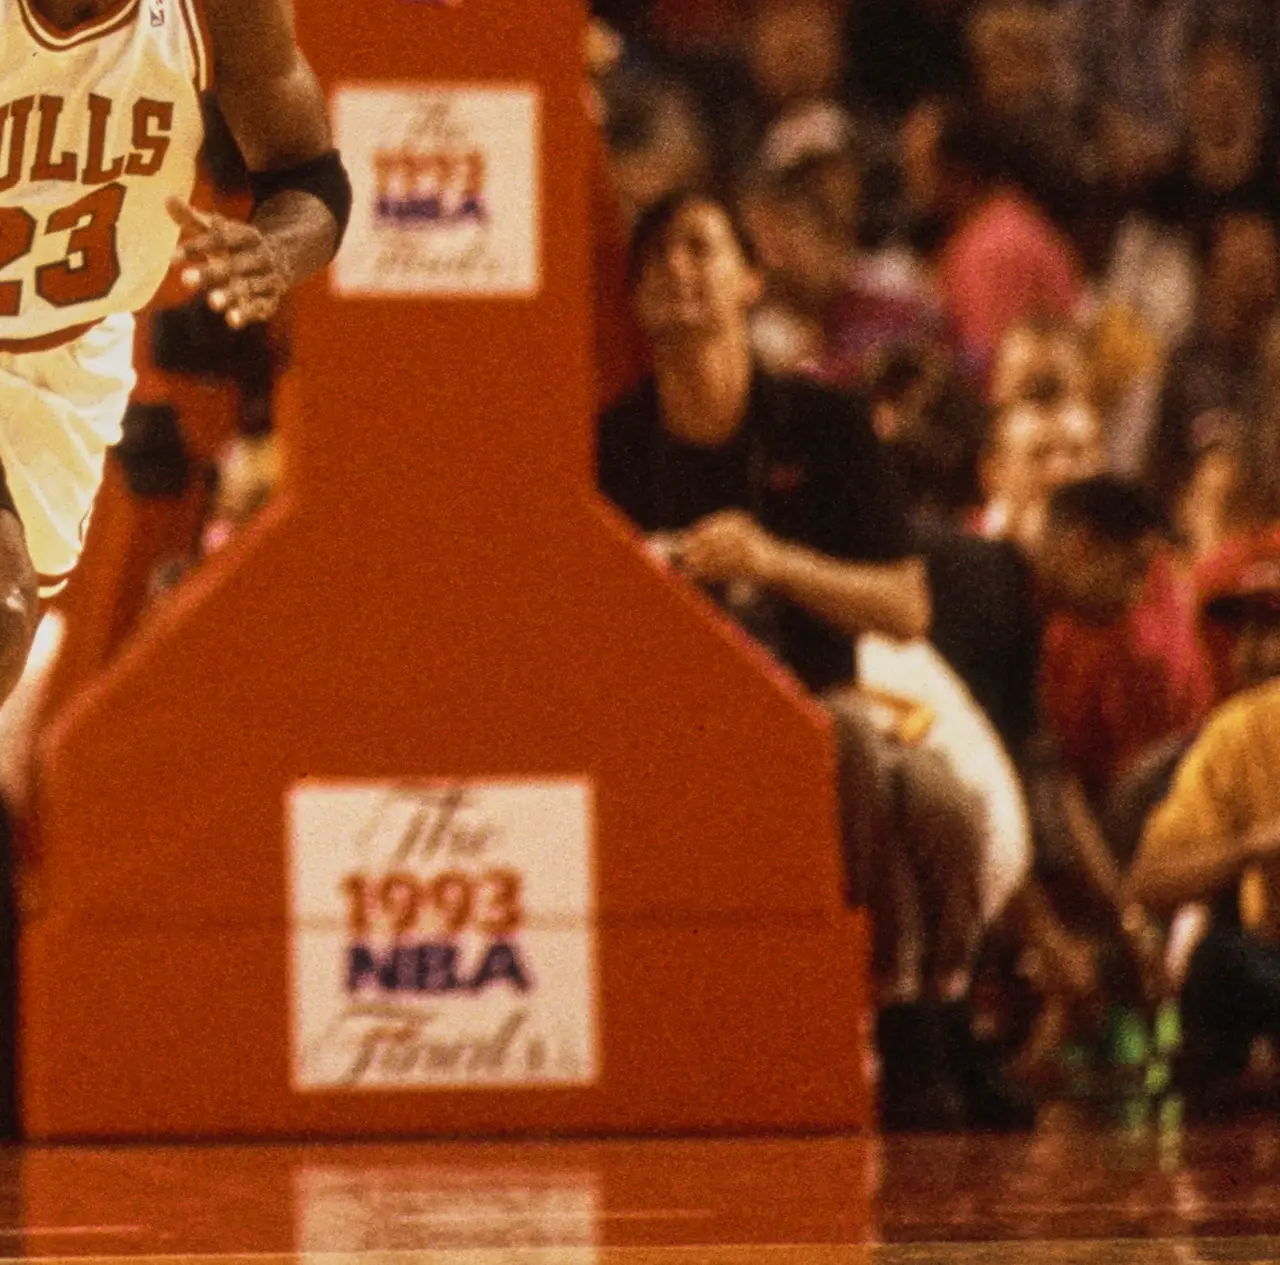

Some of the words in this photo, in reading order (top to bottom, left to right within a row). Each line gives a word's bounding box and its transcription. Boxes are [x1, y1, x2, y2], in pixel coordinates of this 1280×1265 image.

[364, 786, 498, 864] The
[342, 869, 524, 936] 1993
[347, 940, 531, 995] NBA
